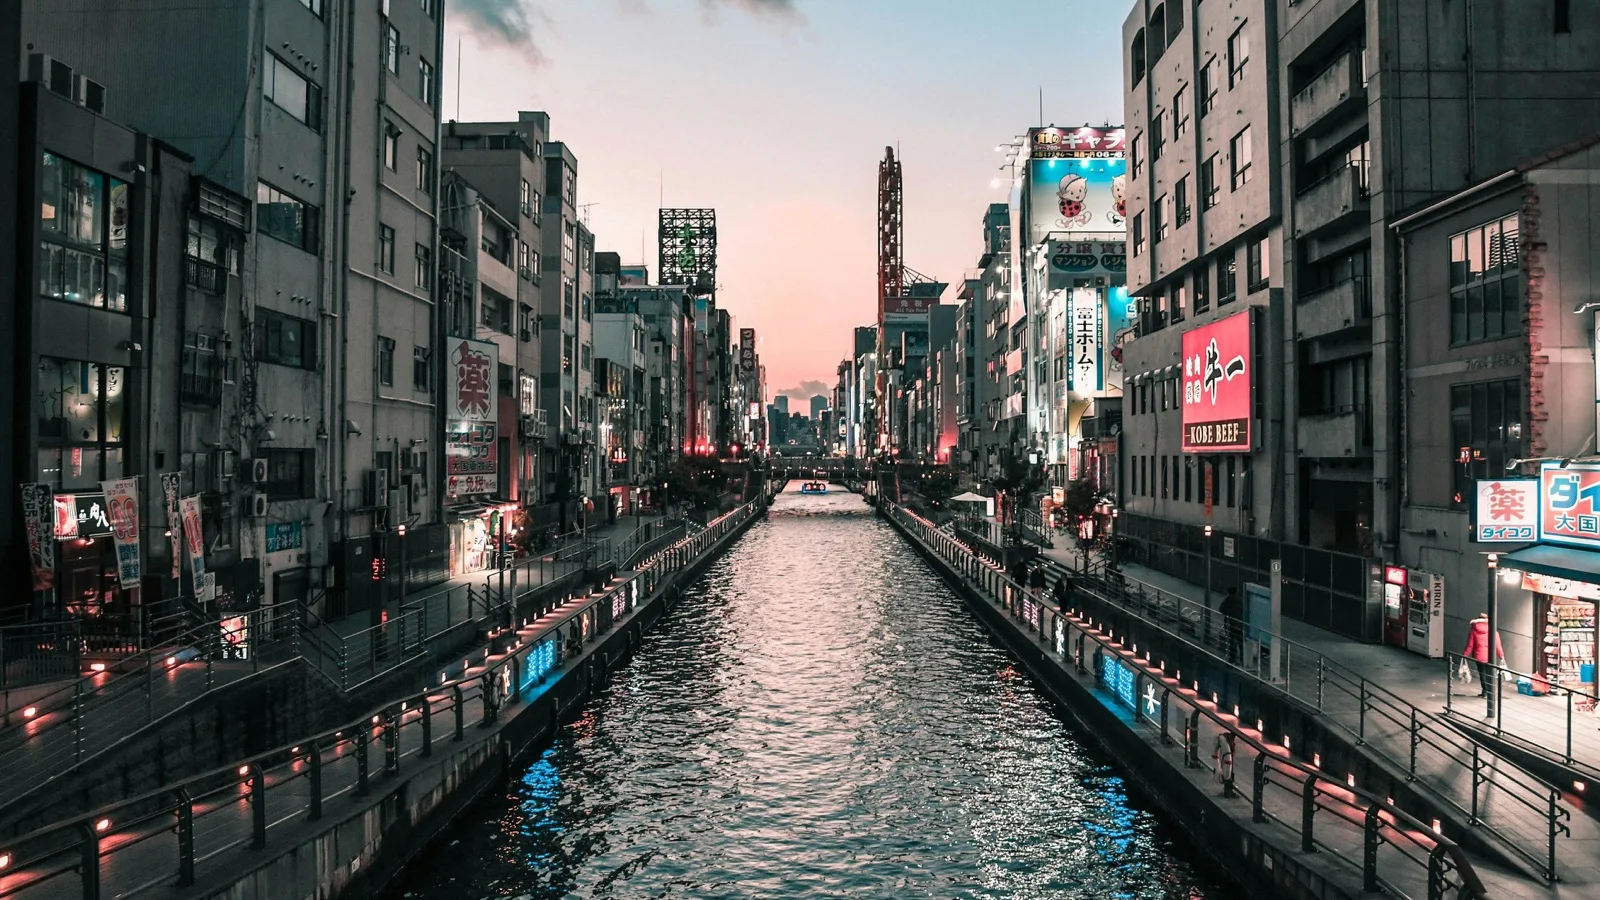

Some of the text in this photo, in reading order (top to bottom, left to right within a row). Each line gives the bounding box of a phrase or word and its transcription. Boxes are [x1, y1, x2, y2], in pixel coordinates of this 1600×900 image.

[1062, 132, 1125, 149] キャラ
[1055, 257, 1095, 266] マンション
[1076, 307, 1093, 365] 富士ホーム
[1204, 338, 1245, 406] 牛一
[458, 354, 490, 416] 薬
[1190, 422, 1239, 443] KOBE BEEF
[1490, 488, 1525, 521] 薬
[1482, 527, 1532, 538] ダイコク
[1556, 513, 1598, 533] 大国
